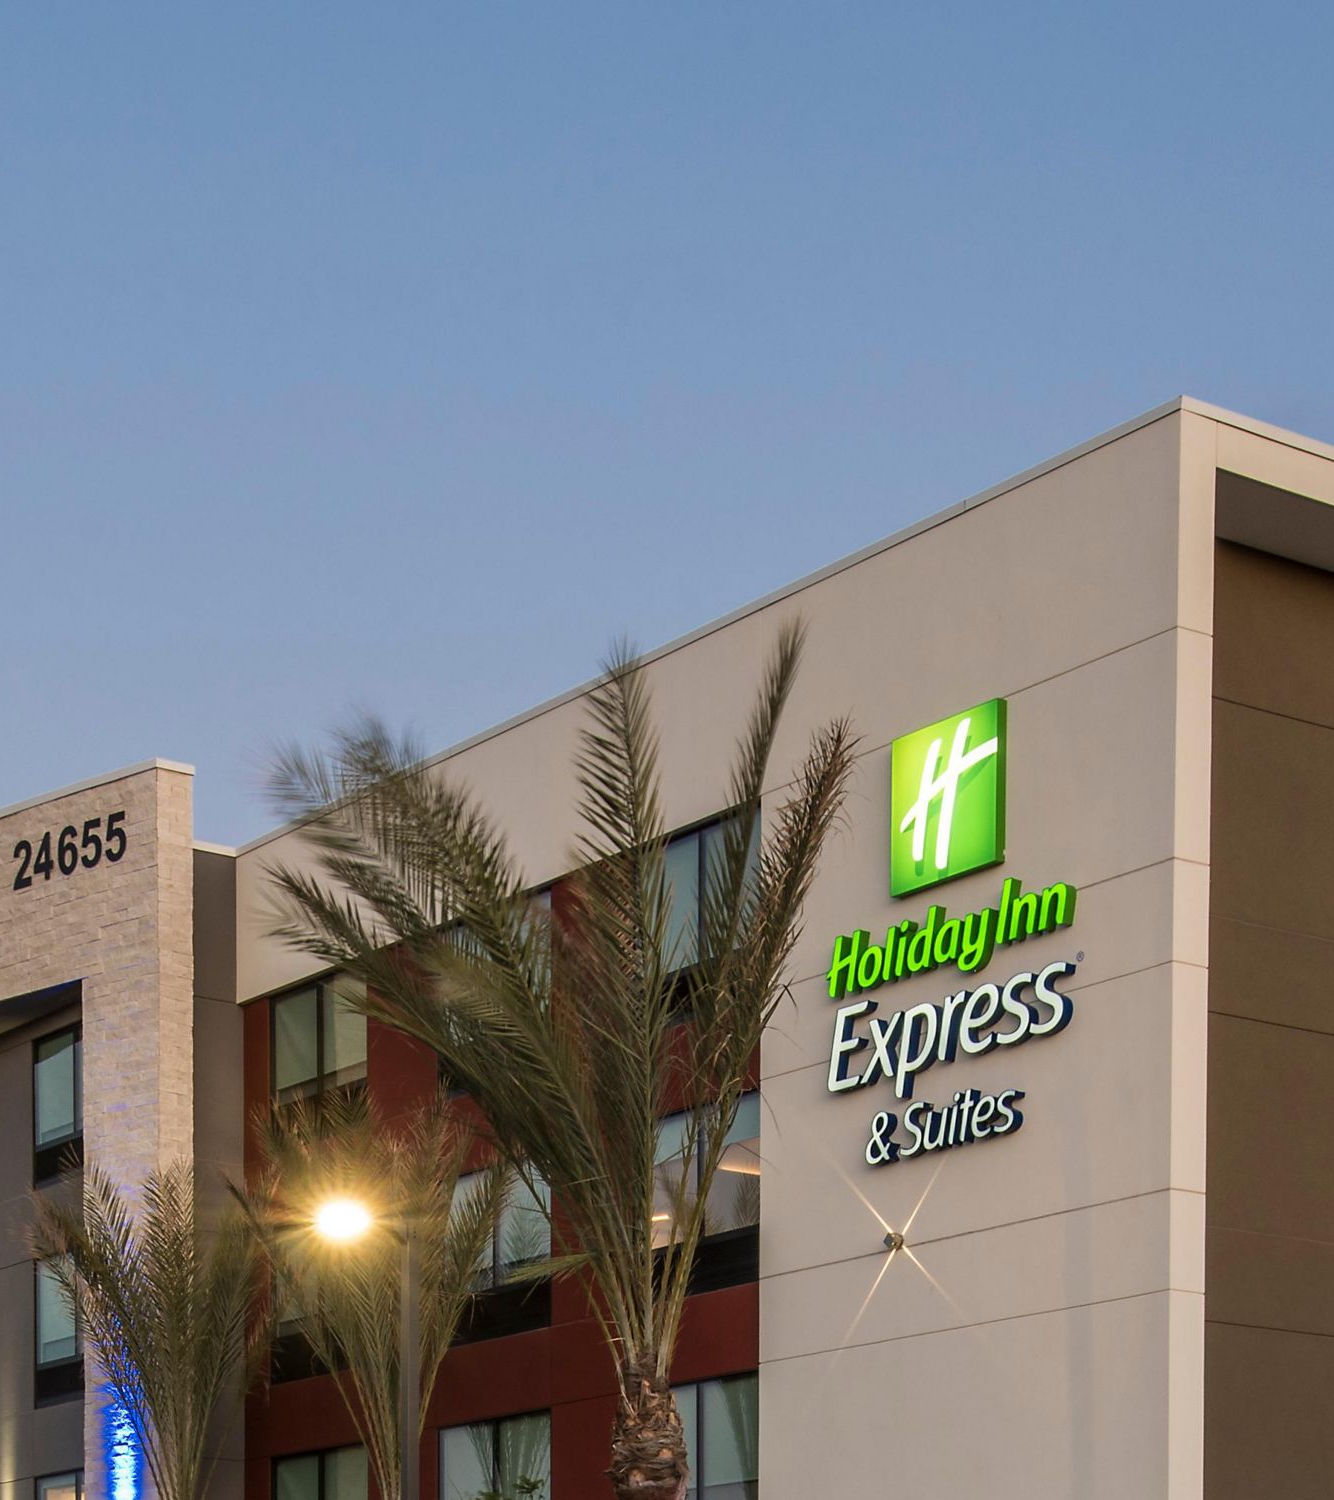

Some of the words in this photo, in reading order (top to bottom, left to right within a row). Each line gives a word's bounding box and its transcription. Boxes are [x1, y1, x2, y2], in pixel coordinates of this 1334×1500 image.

[13, 810, 127, 891] 24655
[827, 905, 996, 999] Holiday
[996, 877, 1077, 946] Inn
[865, 1109, 901, 1165] &
[901, 1088, 1025, 1157] Suites
